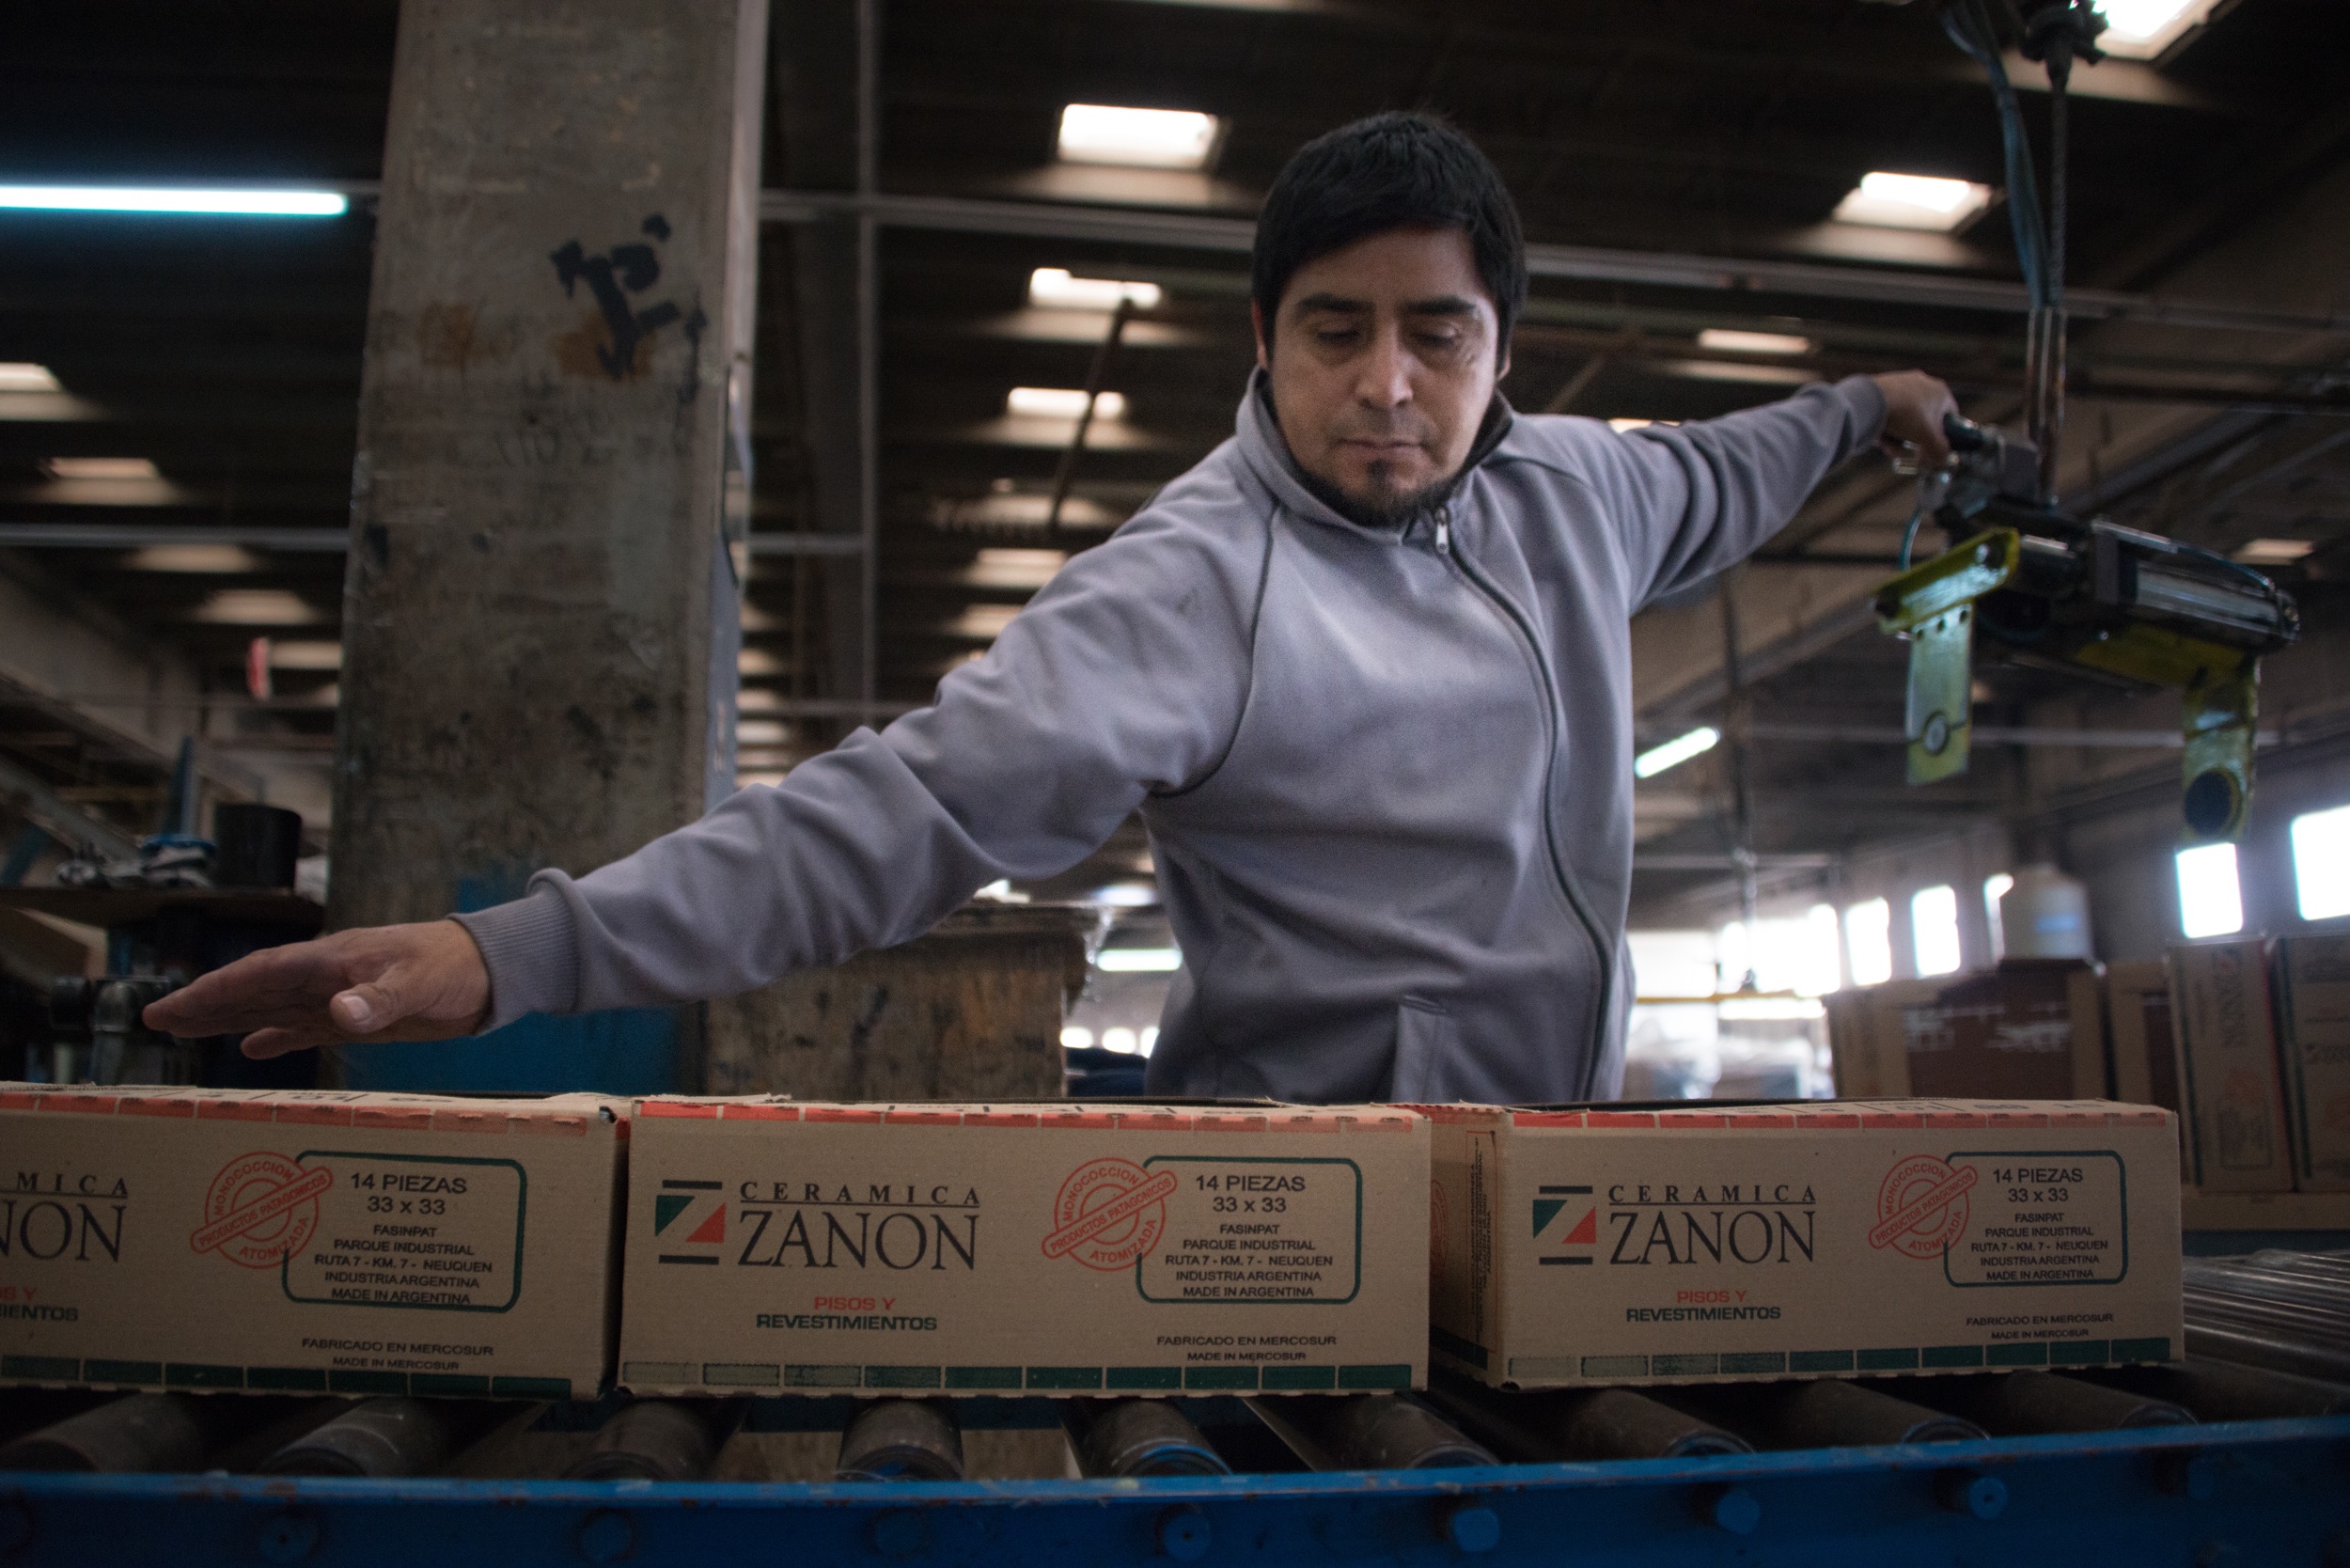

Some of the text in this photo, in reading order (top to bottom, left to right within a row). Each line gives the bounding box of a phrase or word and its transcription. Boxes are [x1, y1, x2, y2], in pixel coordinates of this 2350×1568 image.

[16, 1171, 128, 1195] MICA
[351, 1172, 468, 1194] 14 PIEZAS
[1196, 1175, 1306, 1192] 14 PIEZAS
[1993, 1168, 2083, 1184] 14 PIEZAS
[214, 1161, 294, 1215] MONOCOCCION
[739, 1181, 980, 1205] CERAMICA
[1063, 1166, 1139, 1222] MONOCOCCION
[1608, 1184, 1816, 1202] CERAMICA
[1885, 1163, 1947, 1215] MONOCOCCION
[2008, 1187, 2069, 1202] 33 x 33
[367, 1195, 446, 1215] 33 x 33
[1213, 1196, 1287, 1213] 33 x 33
[1875, 1172, 1974, 1243] PRODUCTOS PATAGONICOS
[1050, 1177, 1172, 1252] PRODUCTOS PATAGONICOS
[2014, 1212, 2064, 1223] FASINPAT
[199, 1210, 258, 1247] PRODUCTOS
[372, 1225, 438, 1238] FASINPAT
[1219, 1224, 1280, 1234] FASINPAT
[1908, 1211, 1963, 1251] ATOMIZADA
[1985, 1226, 2094, 1237] PARQUE INDUSTRIAL
[239, 1217, 309, 1260] ATOMIZADA
[737, 1209, 980, 1271] ZANON
[1089, 1219, 1157, 1262] ATOMIZADA
[1183, 1240, 1316, 1251] PARQUE INDUSTRIAL
[1608, 1210, 1816, 1265] ZANON
[334, 1239, 476, 1256] PARQUE INDUSTRIAL
[1971, 1242, 1999, 1253] RUTA
[2001, 1242, 2007, 1251] 7
[2016, 1242, 2036, 1251] KM.
[2038, 1242, 2044, 1251] 7
[2056, 1240, 2108, 1251] NEUQUEN
[314, 1254, 352, 1266] RUTA
[400, 1258, 409, 1269] 7
[423, 1261, 493, 1273] NEUQUEN
[1165, 1255, 1200, 1265] RUTA
[1202, 1255, 1210, 1265] 7
[1220, 1255, 1244, 1265] KM.
[1246, 1256, 1255, 1265] 7
[1268, 1255, 1333, 1266] NEUQUEN
[1980, 1255, 2100, 1266] INDUSTRIA ARGENTINA
[324, 1271, 479, 1288] INDUSTRIA ARGENTINA
[1176, 1271, 1322, 1281] INDUSTRIA ARGENTINA
[1986, 1269, 2094, 1280] MADE IN ARGENTINA
[331, 1288, 471, 1304] MADE IN ARGENTINA
[1183, 1286, 1314, 1297] MADE IN ARGENTINA
[1676, 1291, 1747, 1304] PISOS Y
[813, 1295, 897, 1311] PISOS Y
[756, 1313, 937, 1332] REVESTIMIENTOS
[1625, 1306, 1781, 1323] REVESTIMIENTOS
[1966, 1313, 2114, 1326] FABRICADO EN MERCOSUR
[1156, 1336, 1337, 1345] FABRICADO EN MERCOSUR
[1991, 1328, 2089, 1340] MADE IN MERCOSUR
[302, 1338, 494, 1356] FABRICADO EN MERCOSUR
[332, 1356, 460, 1370] MADE IN MERCOSUR
[1187, 1352, 1308, 1361] MADE IN MERCOSUR
